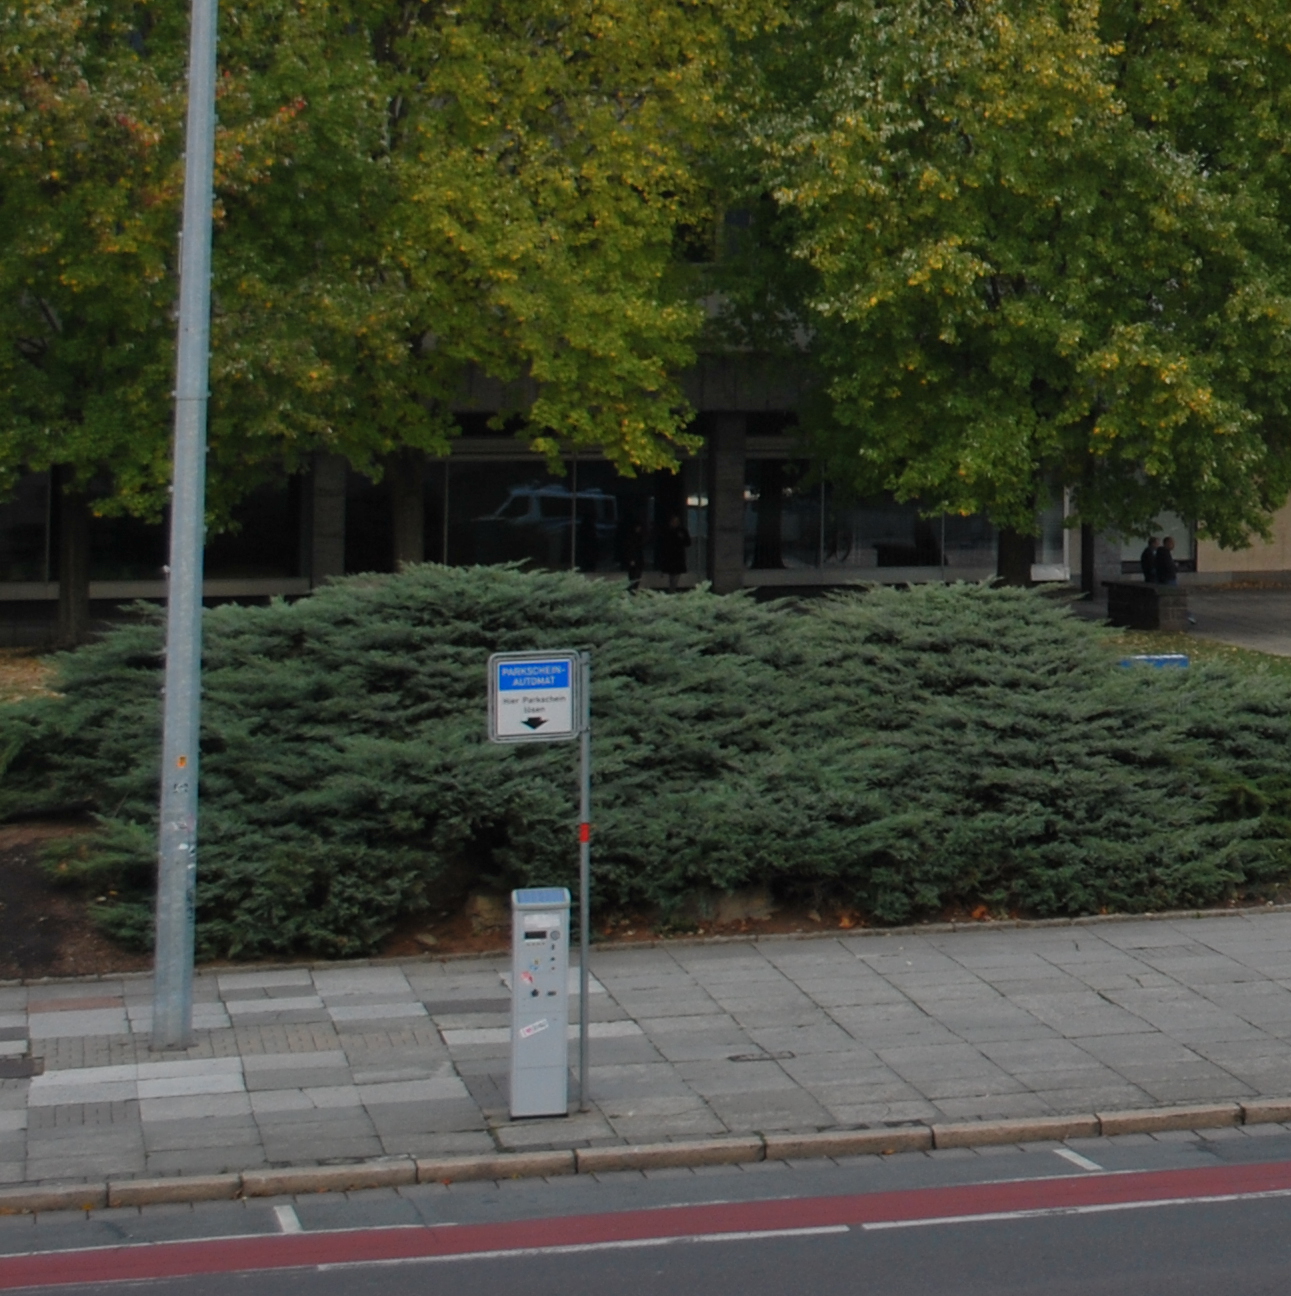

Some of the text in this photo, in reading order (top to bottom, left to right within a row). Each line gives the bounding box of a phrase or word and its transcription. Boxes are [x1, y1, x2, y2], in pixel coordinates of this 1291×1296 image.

[502, 666, 566, 676] PARKSCHEIN-
[512, 676, 555, 686] AUTOMAT
[522, 696, 566, 704] Parkschein
